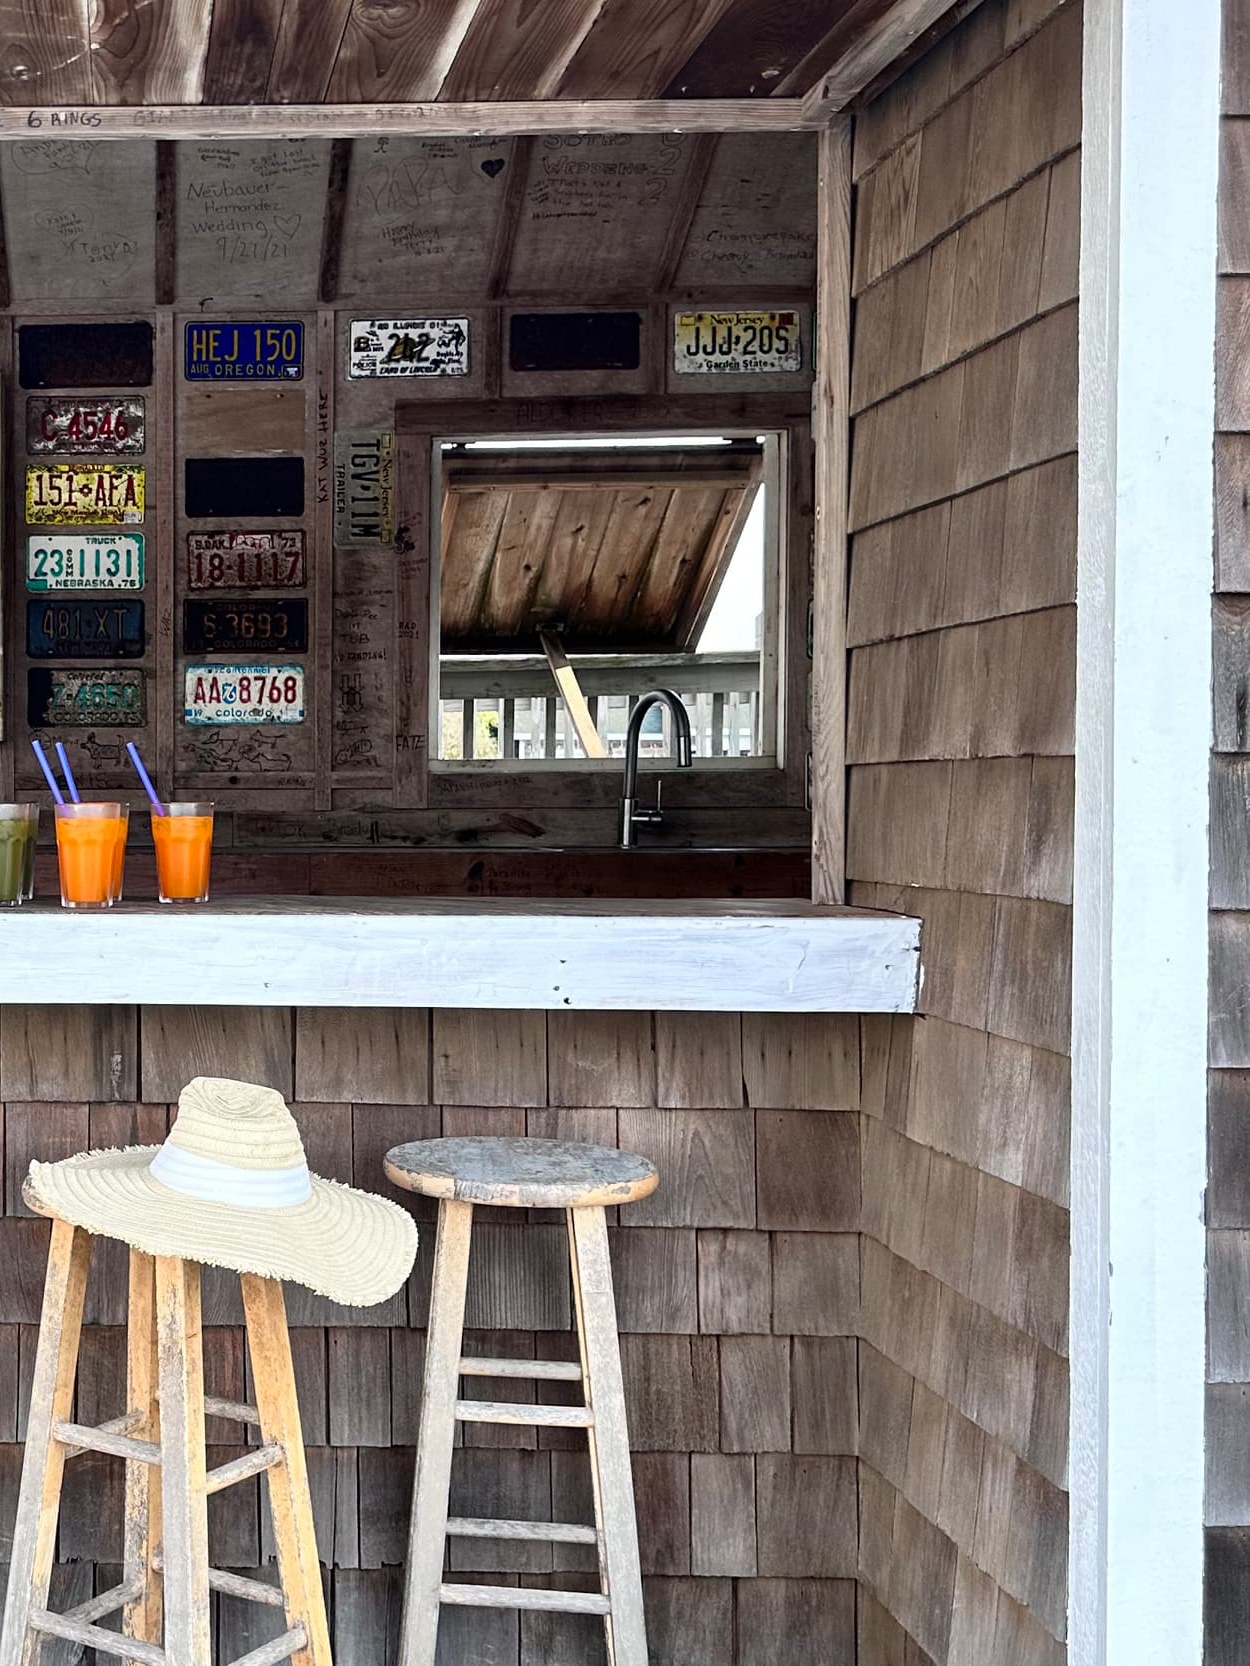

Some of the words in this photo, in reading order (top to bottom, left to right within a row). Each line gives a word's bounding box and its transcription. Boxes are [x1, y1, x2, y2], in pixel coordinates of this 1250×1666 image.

[27, 111, 42, 129] 6
[51, 112, 103, 128] RINGS
[204, 200, 280, 214] Hernandez
[191, 218, 269, 239] Wedding
[710, 314, 734, 325] New
[734, 312, 765, 326] Jersey
[192, 329, 239, 362] HEJ
[253, 329, 297, 361] 150
[190, 365, 209, 374] AUG
[214, 364, 276, 376] OREGON
[705, 360, 740, 370] Garden
[742, 359, 769, 369] State
[317, 388, 329, 433] HERE
[33, 474, 78, 507] 151
[336, 463, 346, 514] TRAILER
[85, 537, 117, 545] TRUCK
[281, 537, 297, 548] 73
[33, 548, 63, 577] 23
[78, 548, 132, 578] 1131
[54, 579, 115, 588] NEBRASKA
[193, 676, 222, 704] AA
[238, 675, 297, 704] 8768
[395, 734, 426, 753] FATE
